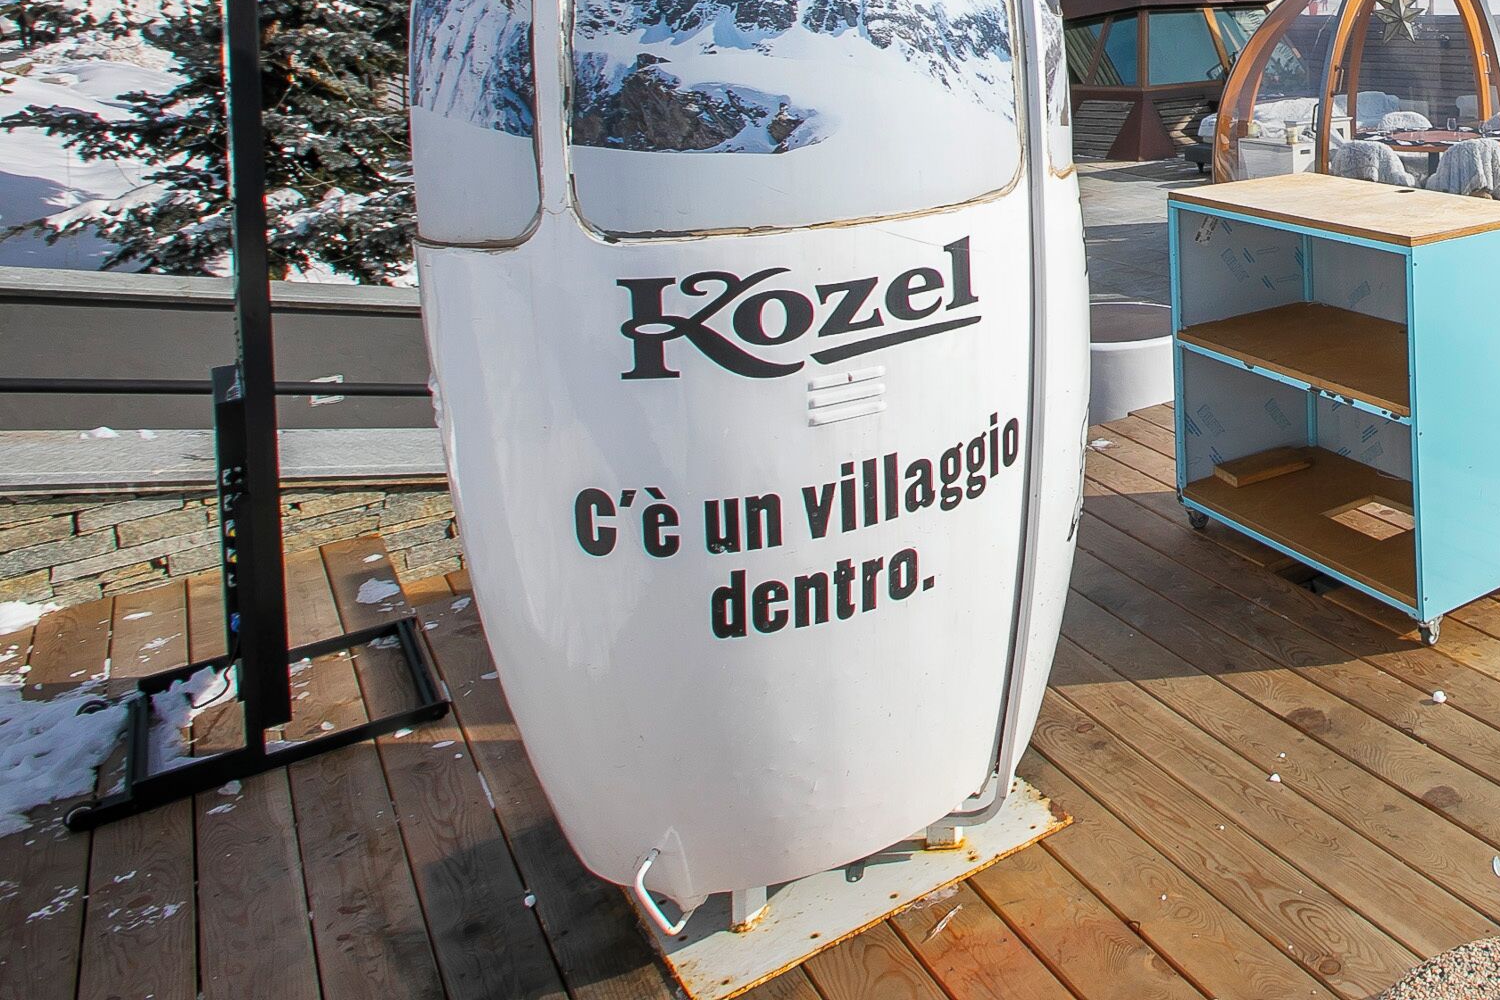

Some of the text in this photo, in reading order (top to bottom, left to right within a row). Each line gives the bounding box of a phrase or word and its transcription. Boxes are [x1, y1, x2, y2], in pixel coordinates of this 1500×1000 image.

[616, 235, 981, 380] Kozel
[574, 412, 1020, 560] C'è un villaggio
[711, 546, 936, 640] dentro.
